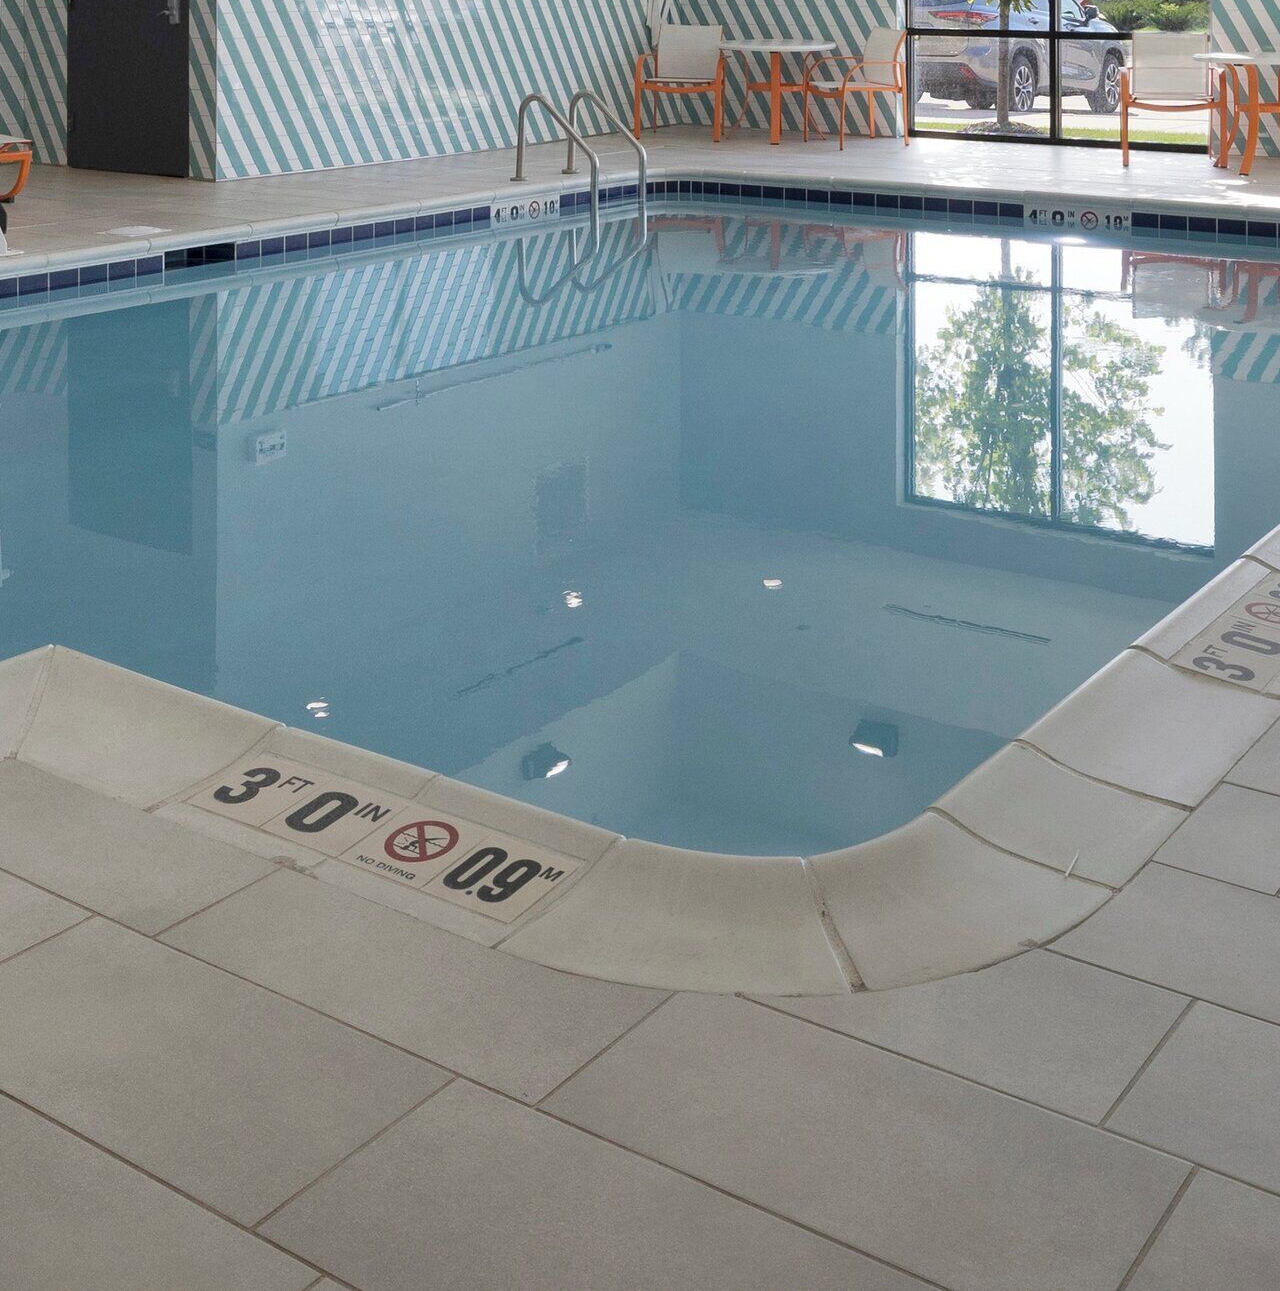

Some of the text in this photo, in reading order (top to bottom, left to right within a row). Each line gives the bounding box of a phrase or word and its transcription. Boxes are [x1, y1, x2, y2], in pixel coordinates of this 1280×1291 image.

[1231, 620, 1256, 633] IN
[1202, 644, 1228, 658] FT
[1192, 656, 1255, 681] 3
[212, 767, 392, 834] 3 FT 0 IN
[356, 853, 417, 882] NO DIVING
[537, 866, 566, 884] M
